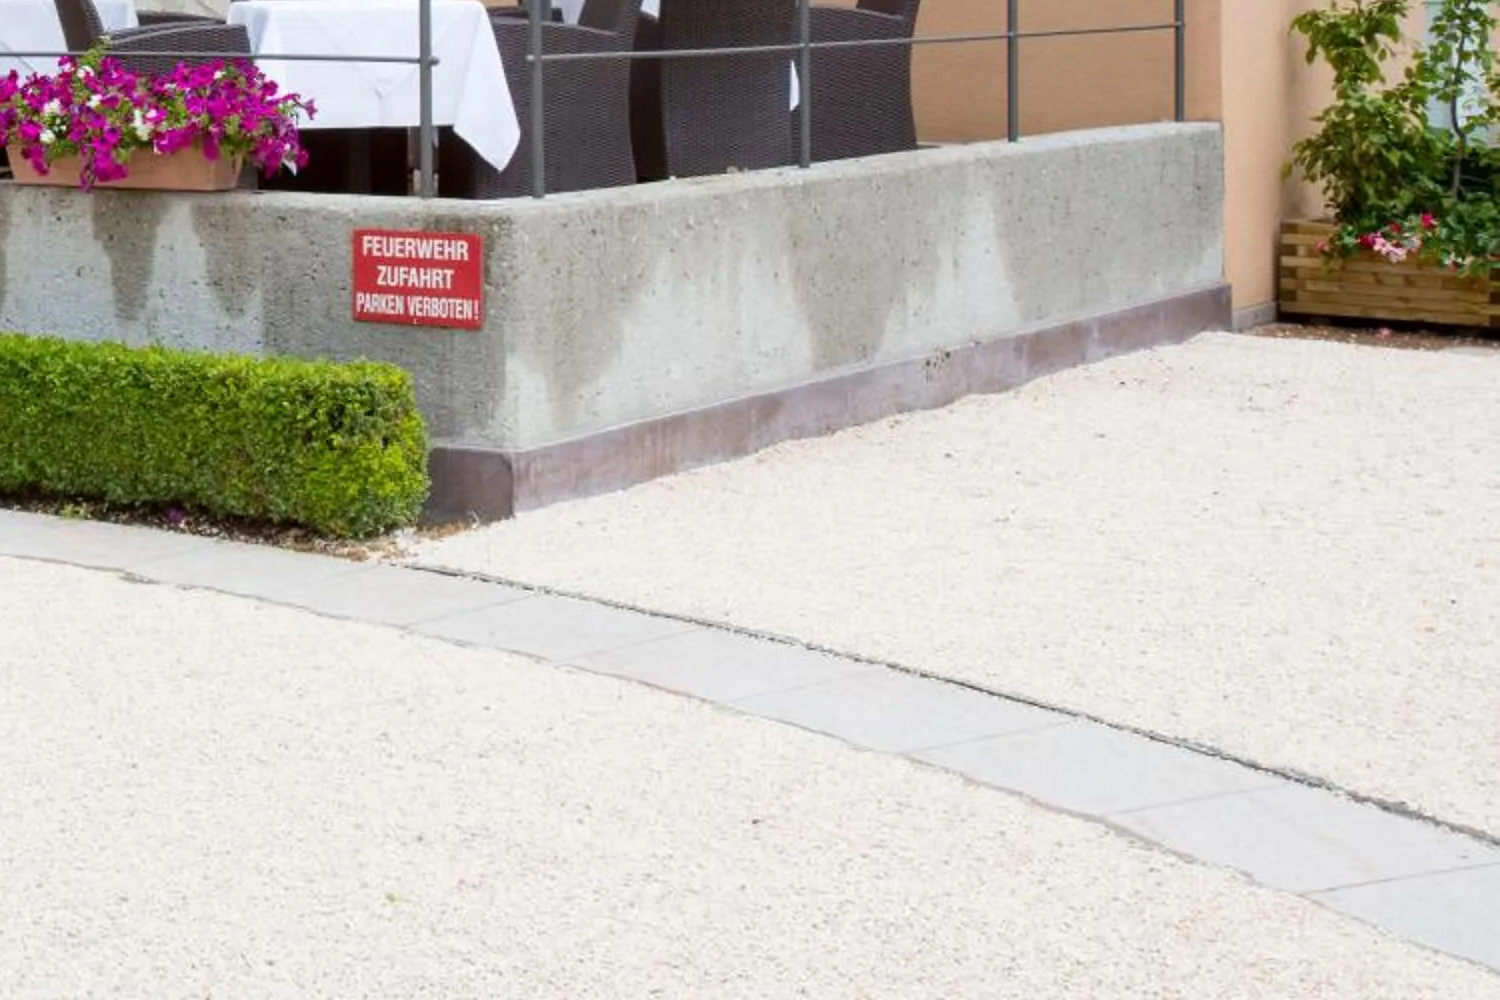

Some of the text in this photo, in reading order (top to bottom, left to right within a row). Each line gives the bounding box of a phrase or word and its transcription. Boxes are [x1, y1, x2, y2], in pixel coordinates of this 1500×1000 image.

[362, 235, 469, 261] FEUERWEHR
[376, 265, 455, 289] ZUFAHRT
[356, 292, 479, 320] PARKEN VERBOTEN!
